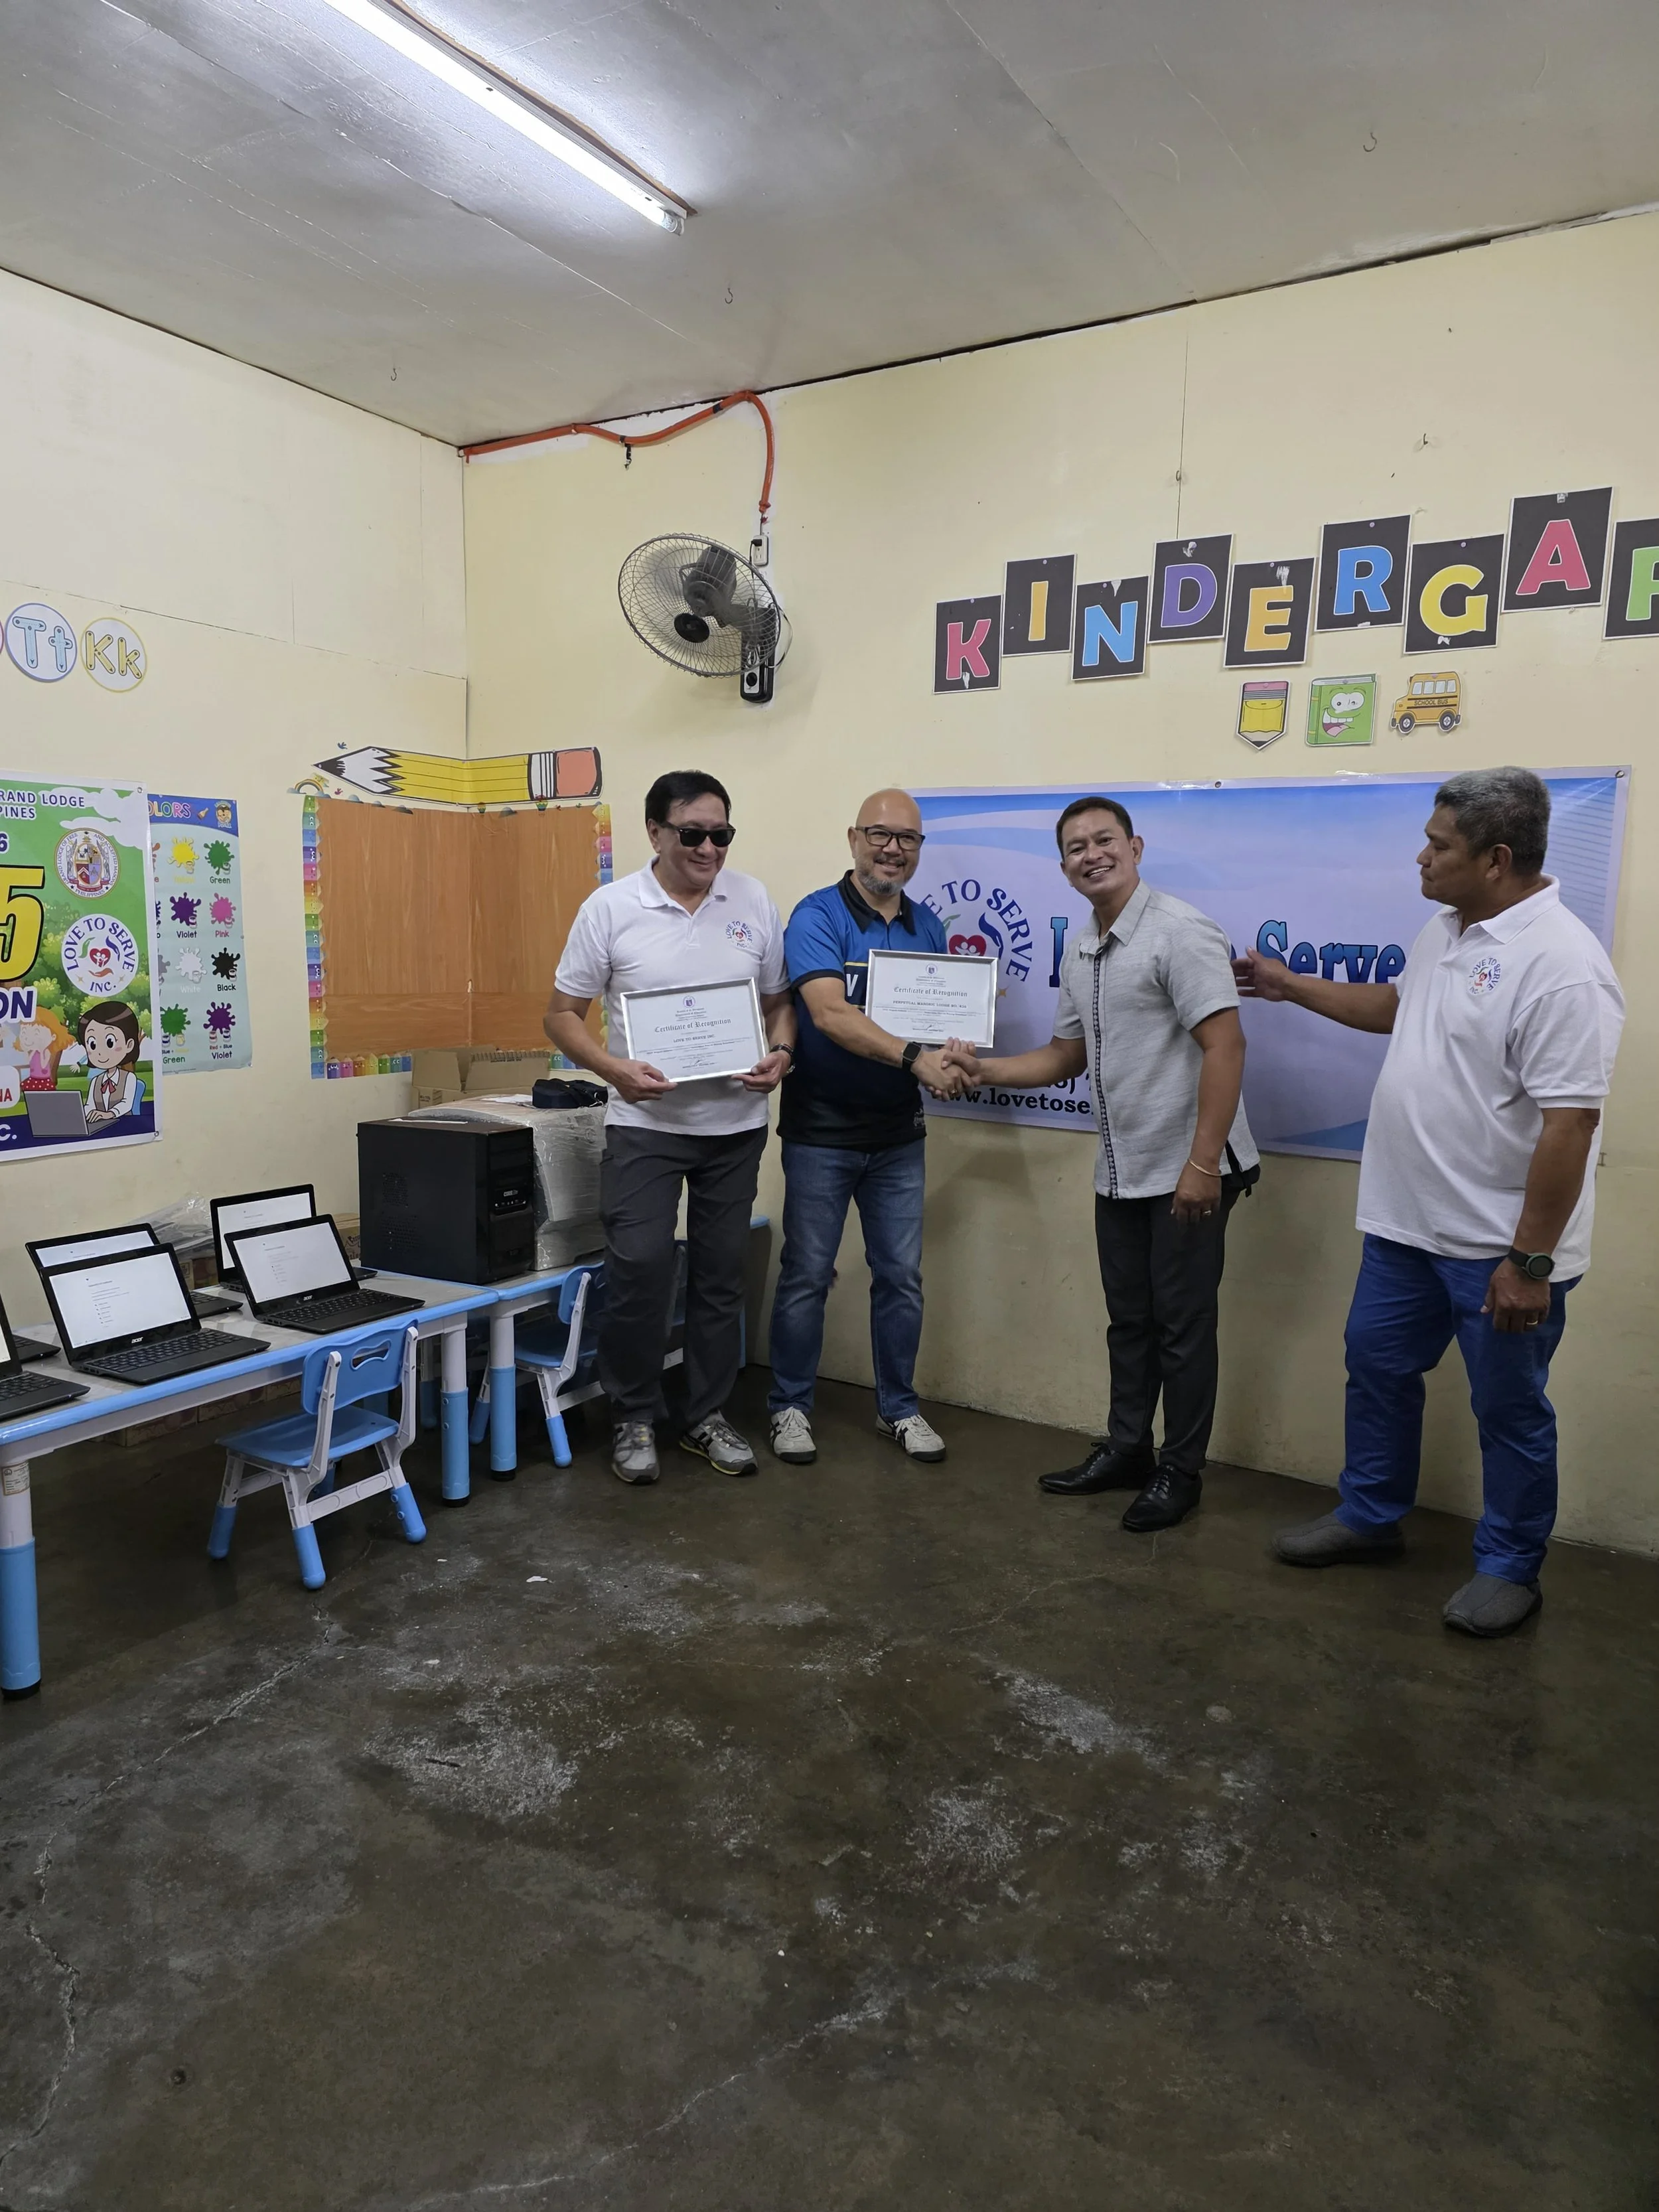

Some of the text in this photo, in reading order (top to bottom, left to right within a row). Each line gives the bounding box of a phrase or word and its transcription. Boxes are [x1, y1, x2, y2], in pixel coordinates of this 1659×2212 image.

[85, 630, 142, 679] Kk
[42, 794, 84, 807] LODGE
[64, 917, 135, 973] LOVE TO SERVE
[942, 879, 981, 904] TO
[987, 888, 1033, 982] SERVE
[1256, 920, 1406, 984] Serve
[90, 982, 116, 992] INC.
[1469, 959, 1486, 978] LOVE
[1486, 964, 1500, 991] SERVE
[654, 1024, 685, 1033] Certificate
[695, 1019, 731, 1028] Recognition
[212, 1051, 232, 1059] Violet
